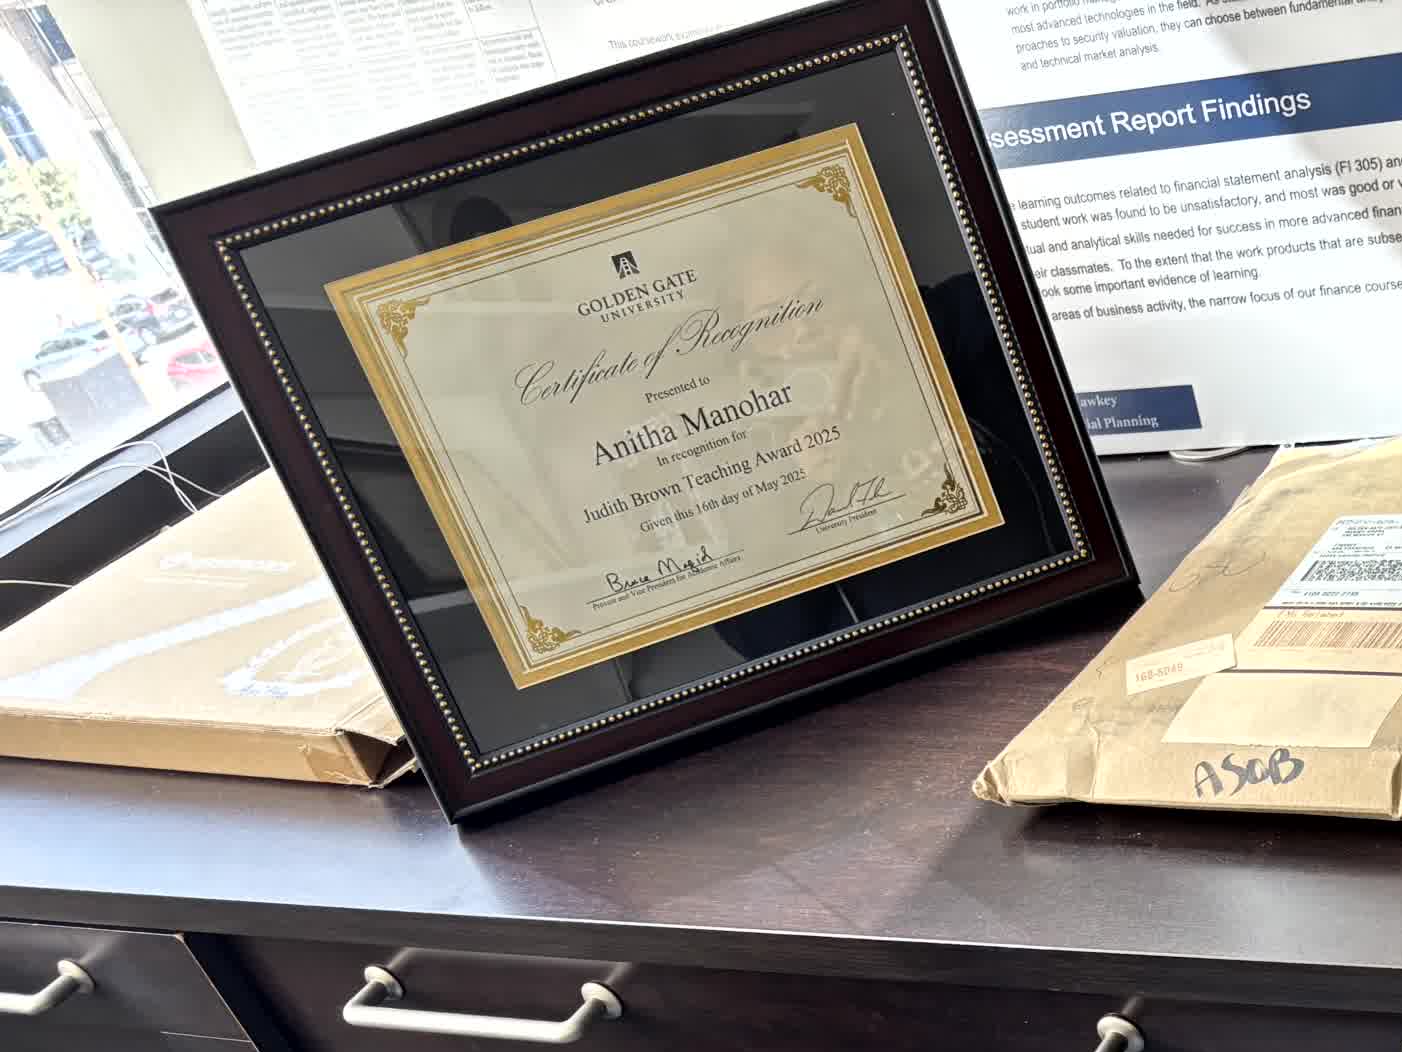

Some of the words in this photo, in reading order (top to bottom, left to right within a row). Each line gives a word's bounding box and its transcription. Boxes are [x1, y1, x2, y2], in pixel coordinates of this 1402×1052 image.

[1109, 103, 1197, 134] Report
[1200, 92, 1311, 122] Findings
[1016, 196, 1061, 210] learning
[1063, 190, 1116, 205] outcomes
[1118, 183, 1157, 198] related
[1159, 183, 1171, 193] to
[1173, 175, 1220, 192] financial
[1223, 169, 1280, 186] statement
[1283, 162, 1332, 180] analysis
[1334, 159, 1351, 176] (FI
[1353, 156, 1383, 172] 305)
[1047, 239, 1068, 253] and
[1070, 233, 1121, 251] analytical
[1123, 231, 1150, 245] skills
[1152, 225, 1195, 240] needed
[1196, 224, 1212, 236] for
[1215, 221, 1262, 235] success
[1263, 217, 1275, 229] in
[1277, 216, 1308, 228] more
[1311, 206, 1369, 224] advanced
[577, 283, 649, 316] GOLDEN
[651, 268, 697, 292] GATE
[599, 288, 683, 323] UNIVERSITY
[1051, 309, 1081, 320] areas
[1082, 305, 1094, 319] of
[1094, 303, 1144, 317] business
[1145, 299, 1186, 312] activity,
[1187, 296, 1206, 309] the
[1208, 295, 1246, 306] narrow
[1249, 291, 1281, 302] focus
[1282, 287, 1294, 300] of
[1297, 287, 1315, 298] our
[1319, 283, 1361, 296] finance
[513, 349, 640, 407] Certificate
[643, 324, 684, 379] of
[676, 296, 825, 357] Recognition
[644, 377, 697, 403] Presented
[697, 376, 710, 386] to
[595, 424, 678, 466] Anitha
[679, 385, 791, 436] Manohar
[1104, 416, 1159, 429] Planning
[655, 455, 669, 466] In
[670, 436, 730, 462] recognition
[730, 430, 746, 442] for
[583, 497, 629, 523] Judith
[629, 482, 681, 507] Brown
[681, 459, 752, 489] Teaching
[755, 438, 802, 466] Award
[803, 425, 840, 449] 2025
[639, 515, 673, 532] Given
[673, 508, 694, 521] this
[695, 498, 720, 513] 16th
[720, 492, 739, 505] day
[741, 484, 753, 498] of
[753, 479, 778, 494] May
[779, 467, 805, 485] 2025
